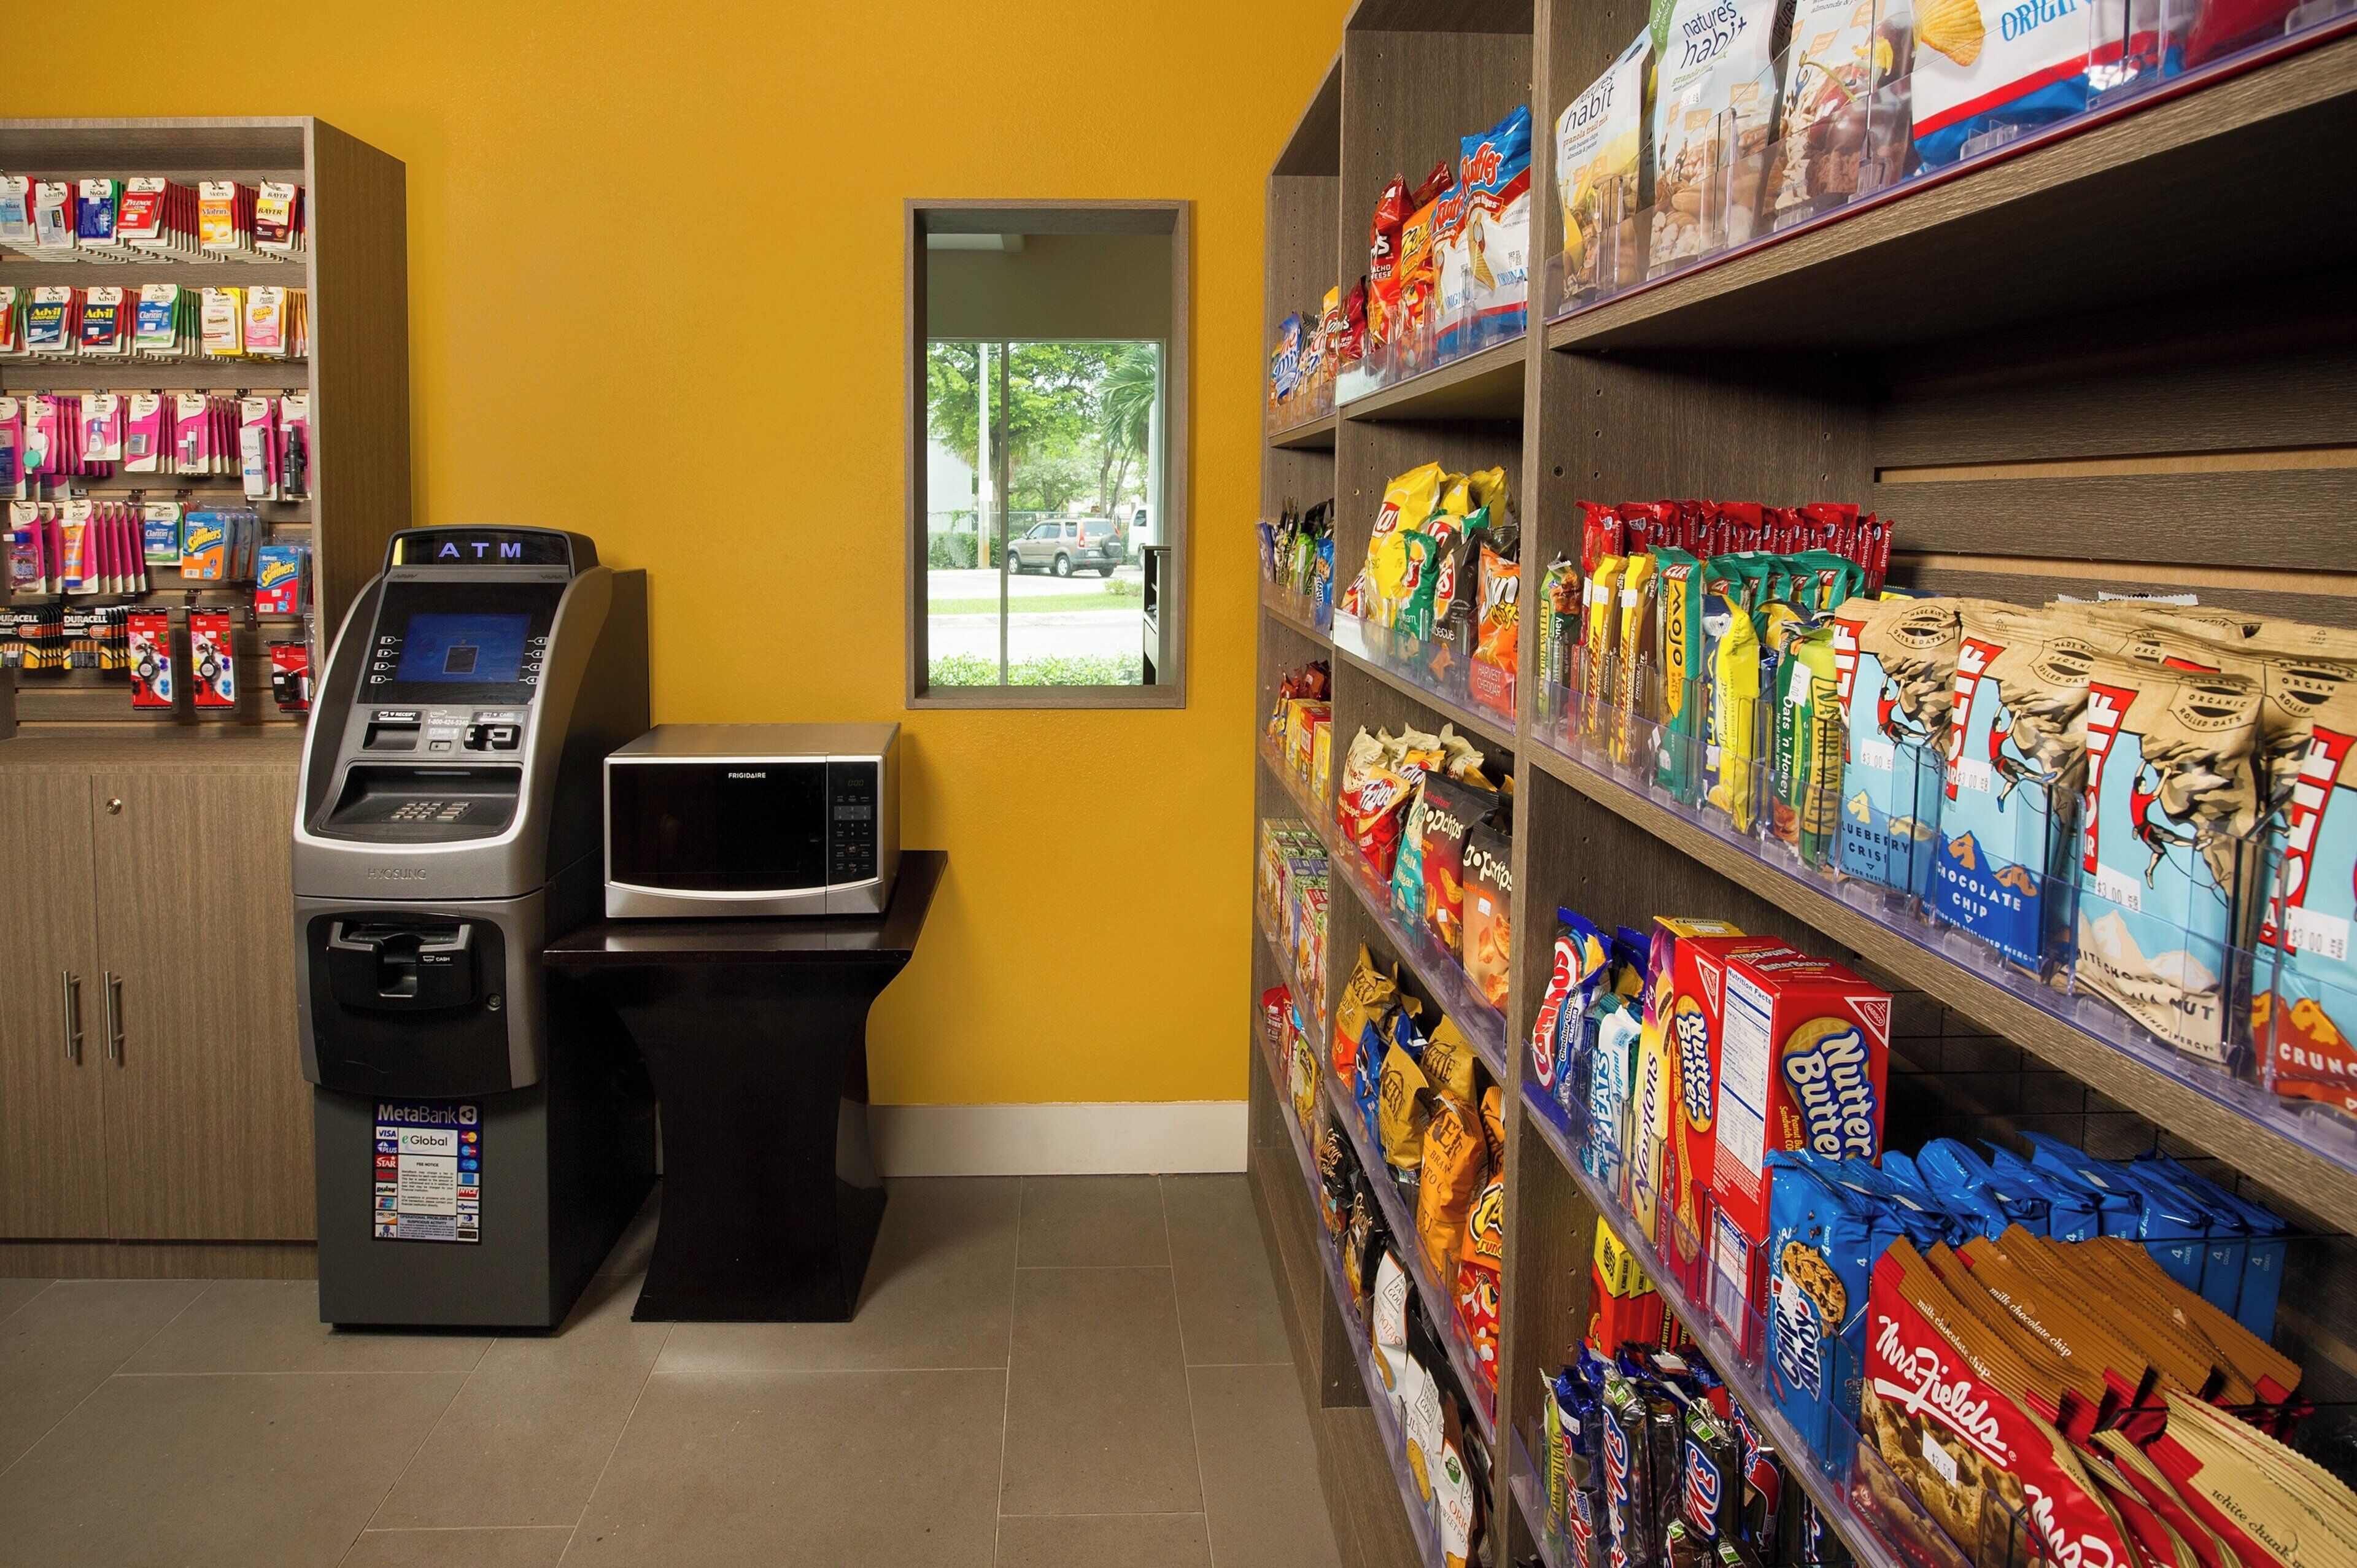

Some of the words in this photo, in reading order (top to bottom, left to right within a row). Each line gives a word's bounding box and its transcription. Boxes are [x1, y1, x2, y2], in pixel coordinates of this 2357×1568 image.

[1680, 16, 1747, 70] habit
[1565, 83, 1615, 133] habit
[1586, 122, 1598, 134] trail
[1599, 114, 1609, 127] mix
[1461, 142, 1504, 202] Ruffles
[84, 309, 114, 318] Advil
[145, 530, 168, 538] Claritin
[188, 529, 222, 553] Swimmers
[193, 527, 207, 538] Little
[1862, 530, 1872, 568] strawberry
[1881, 530, 1891, 568] strawberry
[261, 563, 295, 587] Swimmers
[266, 561, 281, 571] Little
[1665, 565, 1692, 579] CLIF
[1480, 568, 1520, 625] Sun
[1540, 604, 1549, 644] VALLEY
[1910, 609, 1930, 617] MADE
[1930, 609, 1948, 620] WITH
[1628, 625, 1636, 668] ENERGY
[1894, 630, 1910, 644] OATS
[1918, 633, 1947, 645] DATES
[1477, 664, 1502, 683] HARVEST
[1477, 678, 1502, 697] CHEDDAR
[2037, 663, 2062, 682] ROLLED
[1783, 696, 1794, 730] Oats
[1947, 644, 1988, 764] CLIF
[2179, 708, 2209, 727] ROLLED
[2212, 715, 2242, 728] OATS
[2188, 694, 2247, 708] ORGANIC
[2278, 693, 2312, 714] ROLLED
[1815, 685, 1840, 763] NATURE
[1784, 736, 1792, 747] 'n
[1778, 754, 1792, 798] Honey
[2088, 691, 2123, 831] CLIF
[1343, 805, 1361, 817] Recipe
[1360, 779, 1398, 811] Fritos
[1432, 794, 1452, 808] natural
[1809, 765, 1840, 830] VALLEY
[1422, 803, 1465, 841] popchips
[2270, 736, 2338, 899] CLIF
[368, 868, 427, 879] HYOSUNG
[1937, 860, 2021, 912] CHOCOLATE
[1952, 892, 1988, 917] CHIP
[1962, 924, 2001, 949] SUSTAINED
[2003, 944, 2035, 964] ENERGY
[1646, 985, 1656, 1011] Fig
[1727, 968, 1753, 991] Nutrition
[1754, 988, 1772, 1005] Facts
[1568, 1008, 1578, 1043] CRACKER
[1865, 1003, 1885, 1025] NABISCO
[1559, 1021, 1569, 1062] Cheddar
[1612, 1050, 1624, 1103] Original
[1675, 1015, 1698, 1119] Butter
[1688, 1014, 1713, 1120] Nutter
[2278, 1042, 2357, 1079] CRUNC
[1785, 1052, 1842, 1162] Butter
[1821, 1030, 1874, 1157] Nutter
[378, 1104, 458, 1124] MetaBank
[1635, 1051, 1658, 1211] Newtons
[1779, 1105, 1791, 1140] Sandwich
[1790, 1114, 1800, 1138] Peanut
[379, 1129, 397, 1138] VISA
[1320, 1127, 1345, 1166] Stacy's
[1350, 1191, 1373, 1230] Stacy's
[2141, 1207, 2151, 1226] COOKIES
[2138, 1226, 2148, 1237] 4
[1773, 1226, 1794, 1275] ORIGINAL
[1821, 1245, 1831, 1256] 4
[1857, 1257, 1868, 1267] 4
[2171, 1248, 2184, 1259] 4
[2183, 1246, 2193, 1265] COOKIES
[2212, 1250, 2224, 1261] 4
[2223, 1248, 2232, 1265] COOKIES
[2252, 1257, 2264, 1266] 4
[2263, 1253, 2272, 1272] COOKIES
[1916, 1299, 1935, 1318] milk
[1934, 1315, 1970, 1356] chocolate
[1969, 1355, 1992, 1378] chip
[1989, 1285, 2009, 1304] milk
[2008, 1301, 2050, 1342] chocolate
[2050, 1337, 2073, 1358] chip
[1913, 1346, 2008, 1451] Fields
[1551, 1429, 1565, 1478] NATURE
[1439, 1505, 1456, 1530] SWEET
[2212, 1489, 2249, 1525] white
[2248, 1520, 2293, 1561] chunk
